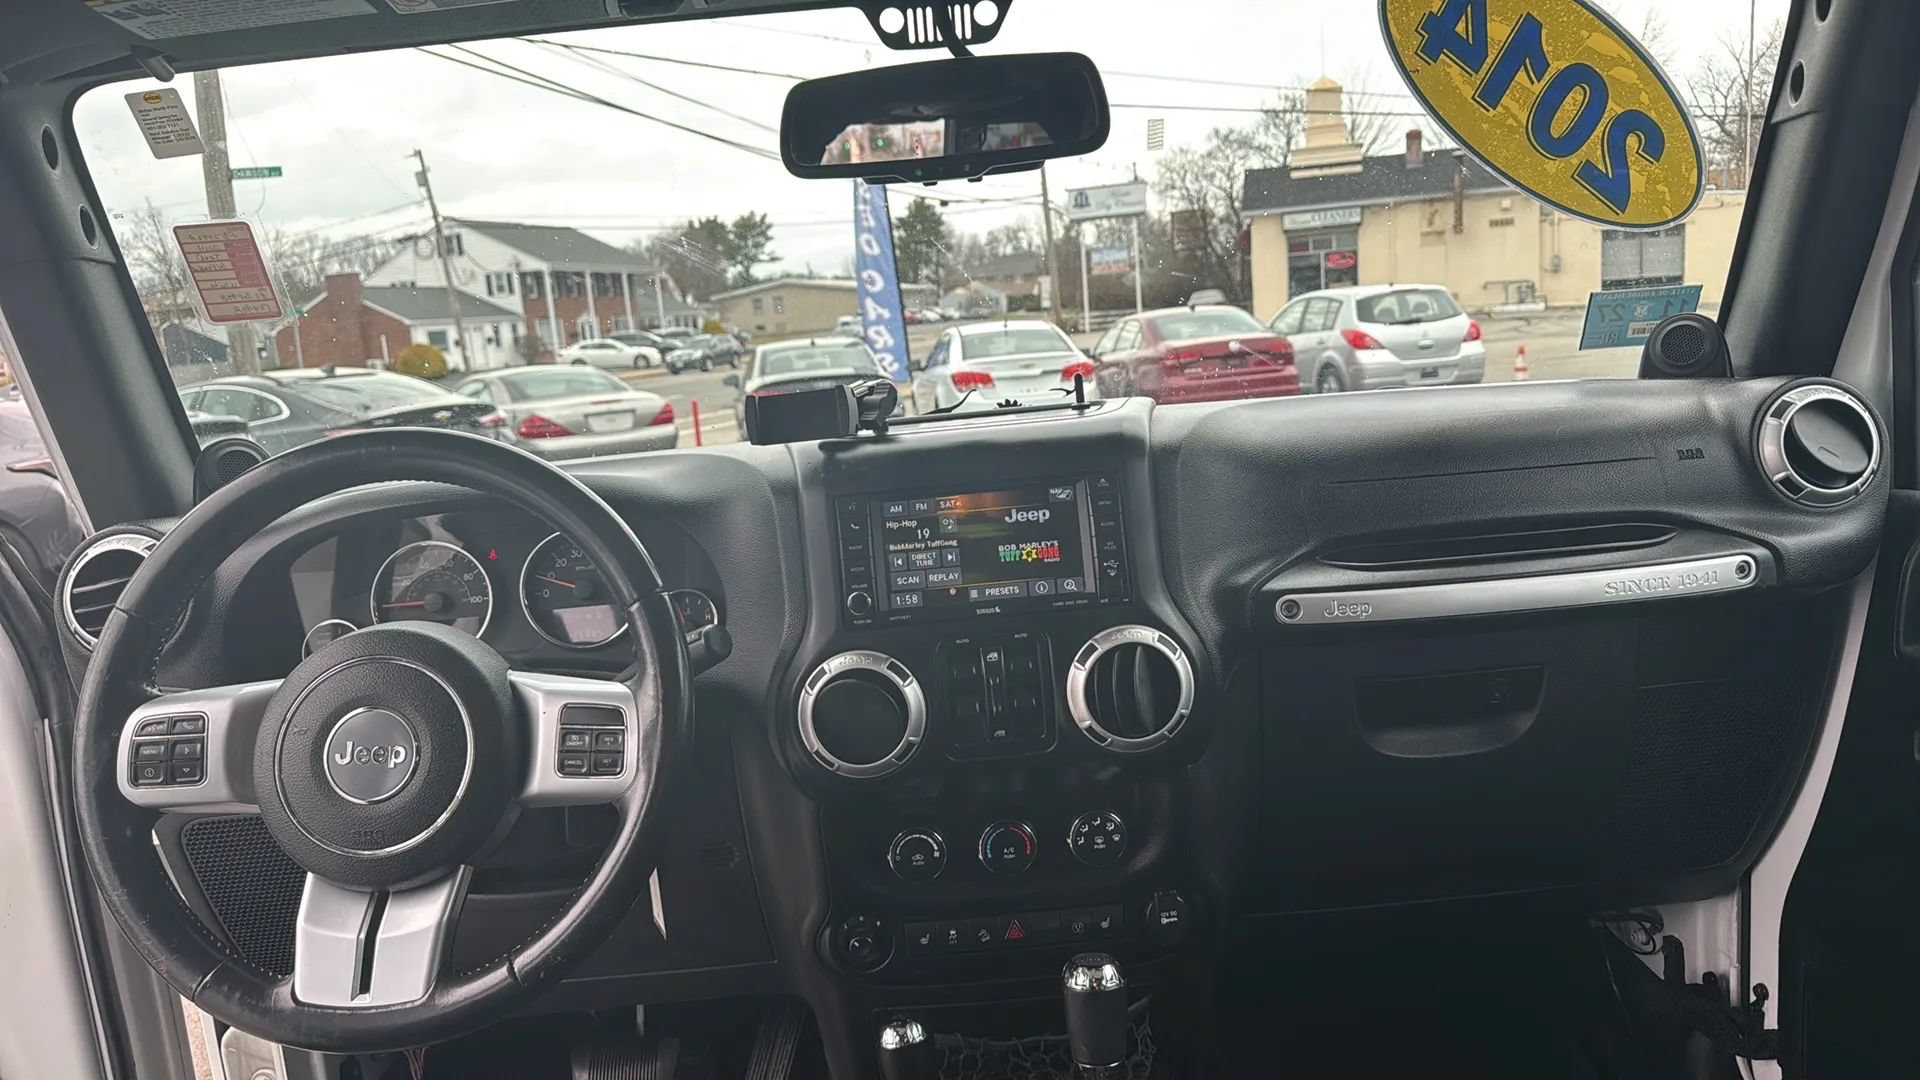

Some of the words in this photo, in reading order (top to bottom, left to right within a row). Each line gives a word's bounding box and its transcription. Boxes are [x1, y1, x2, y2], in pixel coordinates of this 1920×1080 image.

[890, 505, 902, 513] AM
[915, 502, 928, 510] FM
[940, 500, 955, 509] SAT
[1004, 508, 1050, 524] Jeep
[886, 520, 918, 529] Hip-Hop
[917, 528, 930, 540] 19
[889, 543, 925, 551] BobMarley
[927, 540, 958, 548] TuffGong
[998, 544, 1017, 552] BOB
[1019, 540, 1059, 550] MARLEY'S
[911, 552, 936, 560] DIRECT
[999, 550, 1020, 562] TUFF
[1037, 547, 1060, 559] GONG
[555, 559, 567, 567] 20
[916, 559, 934, 567] TUNE
[897, 575, 919, 585] SCAN
[929, 572, 959, 582] REPLAY
[1604, 576, 1671, 596] SINCE
[1678, 571, 1719, 588] 1941
[543, 588, 550, 598] 0
[985, 586, 1020, 596] PRESETS
[896, 594, 918, 605] 1:58
[1324, 600, 1372, 618] Jeep
[335, 741, 406, 768] Jeep
